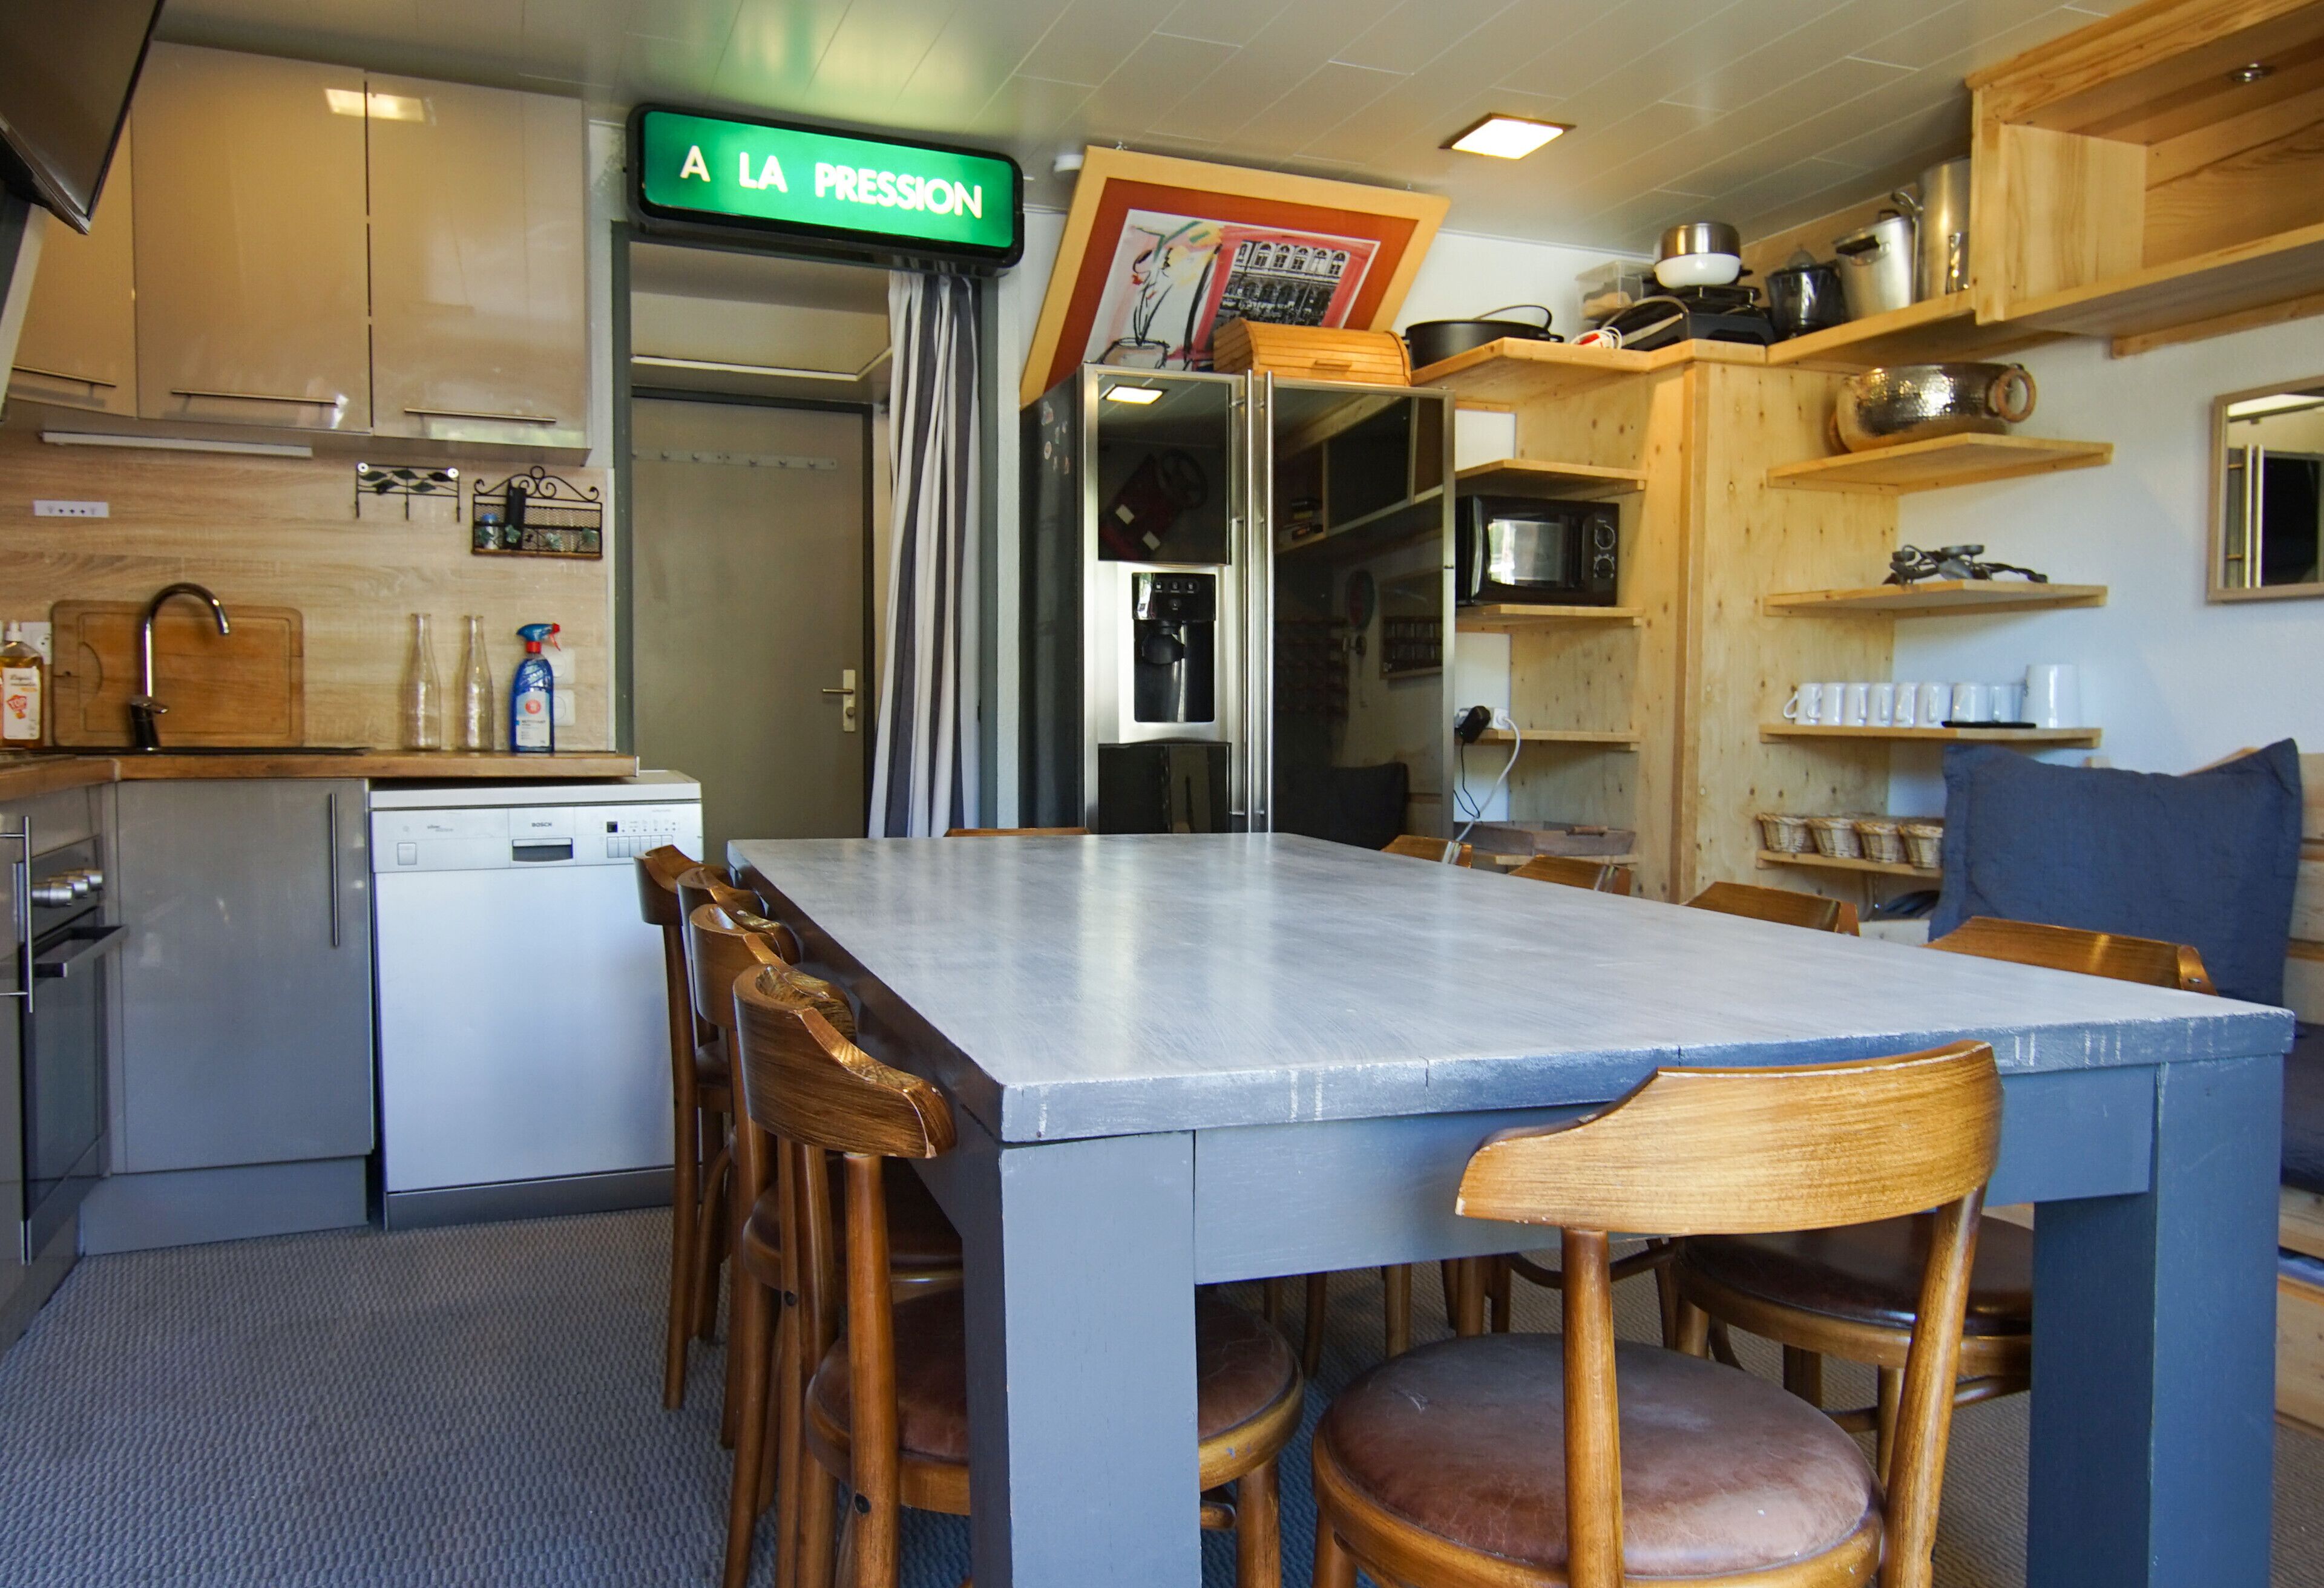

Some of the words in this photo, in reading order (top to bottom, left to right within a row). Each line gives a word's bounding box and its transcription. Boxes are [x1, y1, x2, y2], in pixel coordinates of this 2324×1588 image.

[680, 145, 711, 182] A
[738, 151, 789, 193] LA
[815, 162, 983, 219] PRESSION
